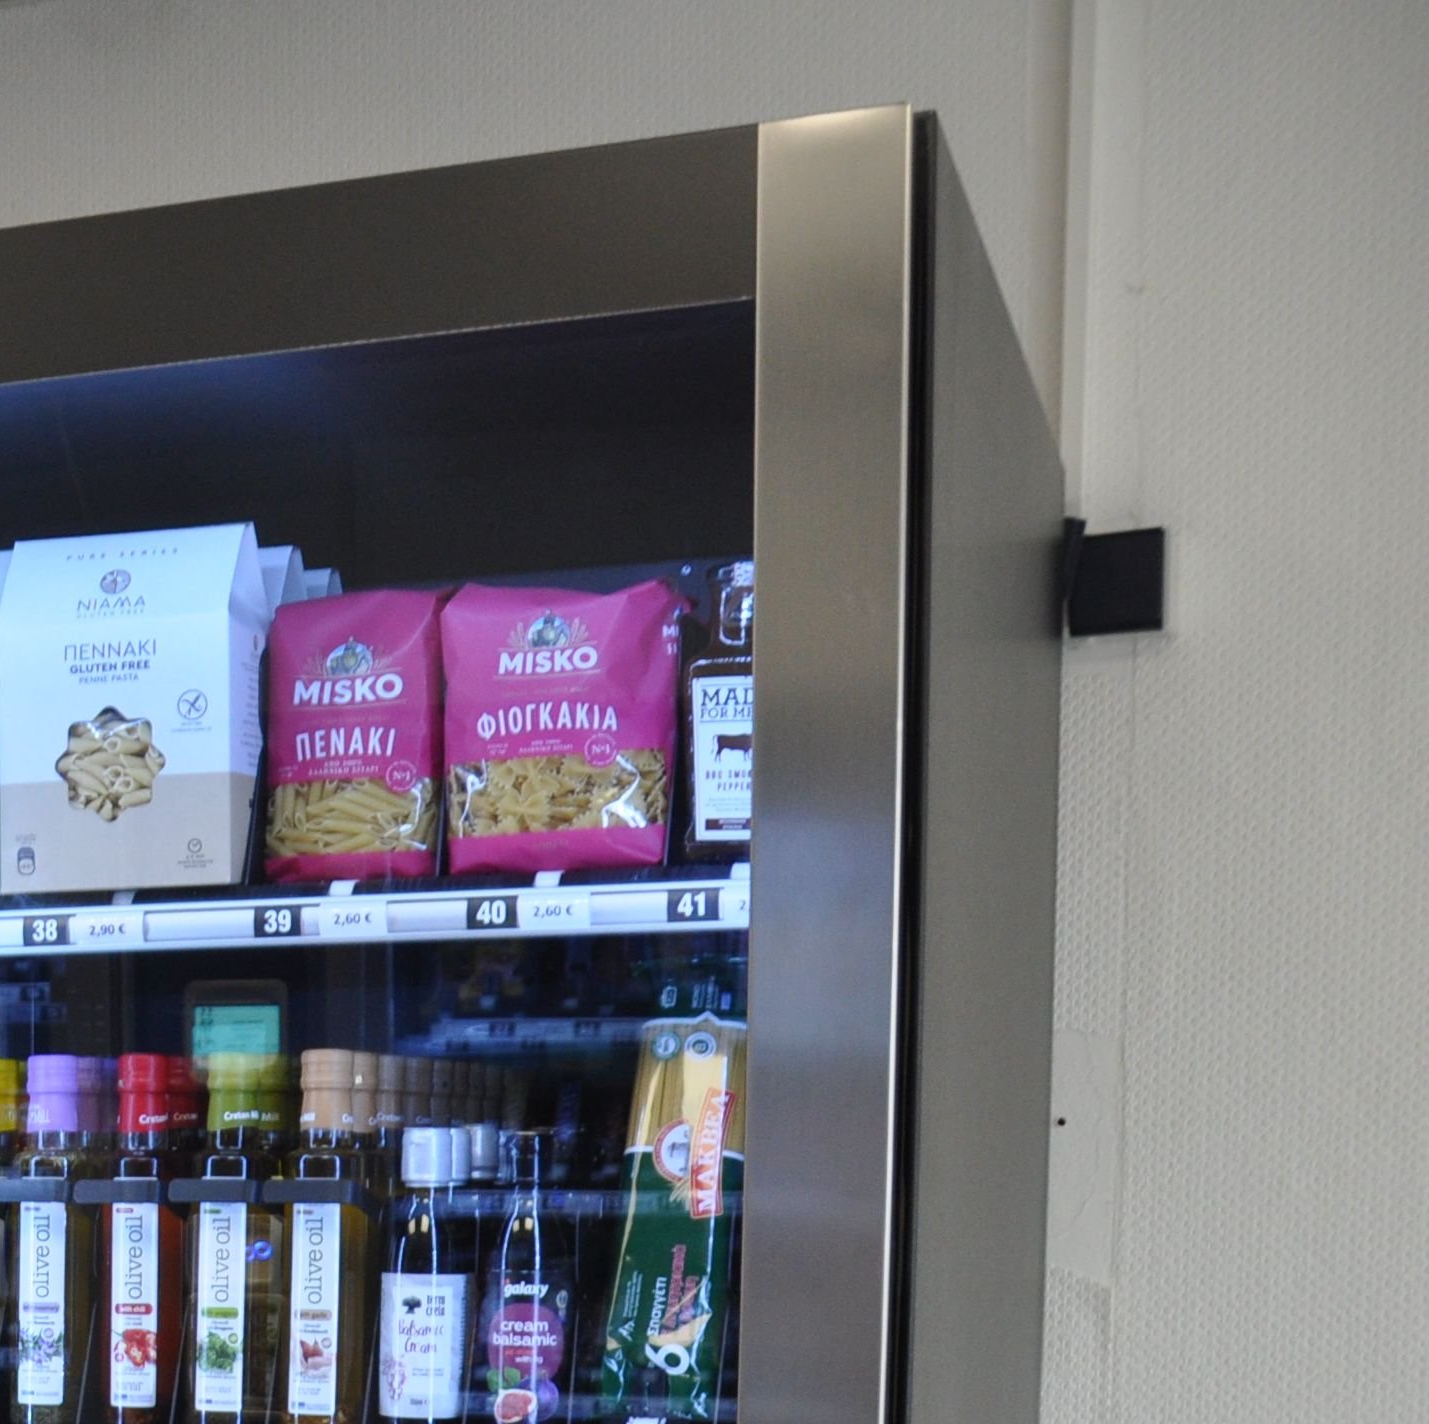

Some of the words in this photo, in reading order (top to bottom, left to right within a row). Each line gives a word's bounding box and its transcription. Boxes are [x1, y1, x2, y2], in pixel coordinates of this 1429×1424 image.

[77, 595, 146, 612] NIAMA
[64, 639, 157, 661] ΠΕΝΝΑΚΙ
[498, 646, 598, 676] MISKO
[70, 662, 117, 674] GLUTEN
[121, 660, 151, 671] FREE
[293, 673, 404, 706] MISKO
[477, 700, 618, 741] ΦΙΟΓΚΑΚΙΑ
[700, 707, 728, 719] FOR
[295, 726, 397, 762] ΠΕΝΑΚΙ
[475, 900, 507, 926] 40
[533, 904, 563, 919] 2,60
[676, 891, 707, 917] 41
[31, 918, 58, 943] 38
[89, 923, 115, 938] 2,90
[264, 908, 292, 934] 39
[33, 1215, 51, 1242] oil
[125, 1215, 143, 1243] oil
[213, 1216, 231, 1245] oil
[305, 1216, 324, 1246] oil
[33, 1245, 50, 1299] olive
[125, 1246, 143, 1299] olive
[212, 1248, 230, 1303] olive
[304, 1249, 323, 1304] olive
[504, 1281, 549, 1298] galaxy
[493, 1332, 557, 1346] balsamic
[501, 1320, 548, 1332] cream
[644, 1343, 690, 1376] 6
